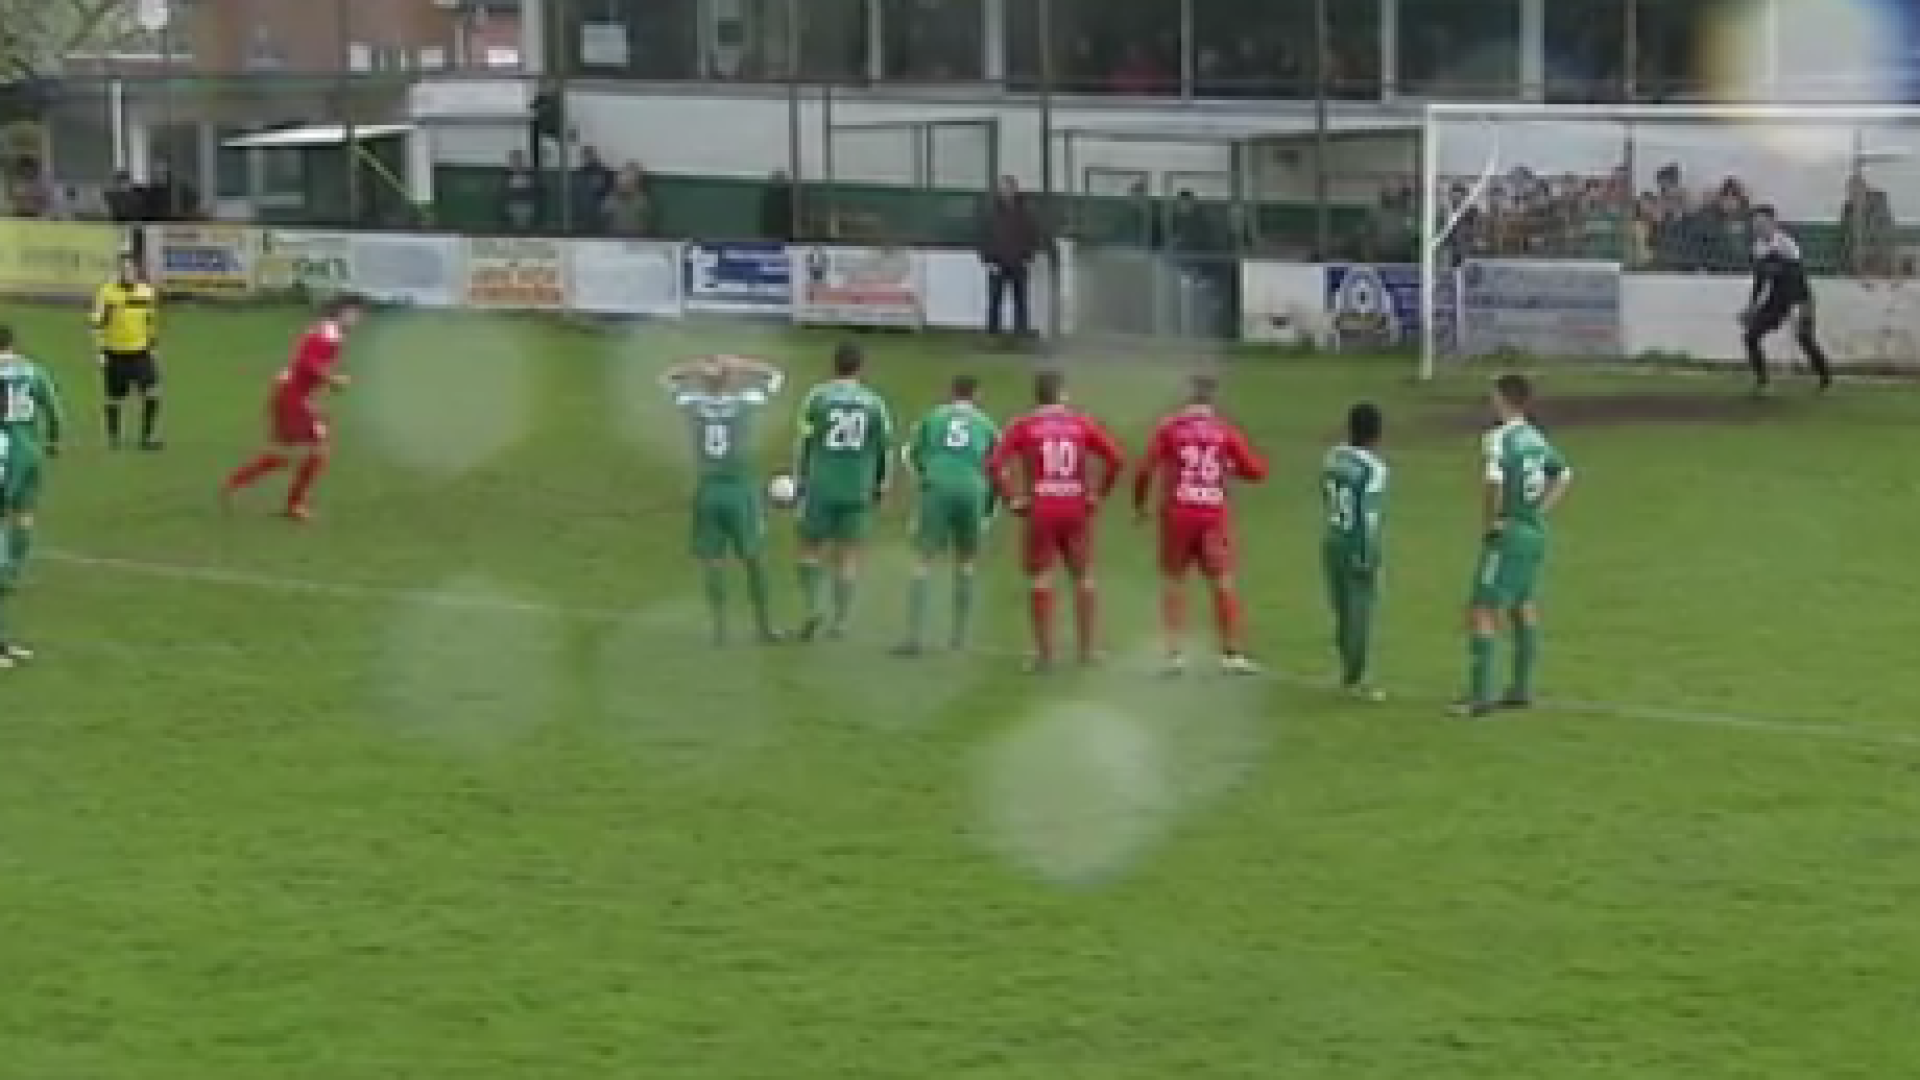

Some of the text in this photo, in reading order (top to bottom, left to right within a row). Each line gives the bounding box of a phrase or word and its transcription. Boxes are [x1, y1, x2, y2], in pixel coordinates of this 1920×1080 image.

[825, 411, 864, 447] 20
[1041, 439, 1077, 476] 10
[1180, 445, 1220, 480] 26
